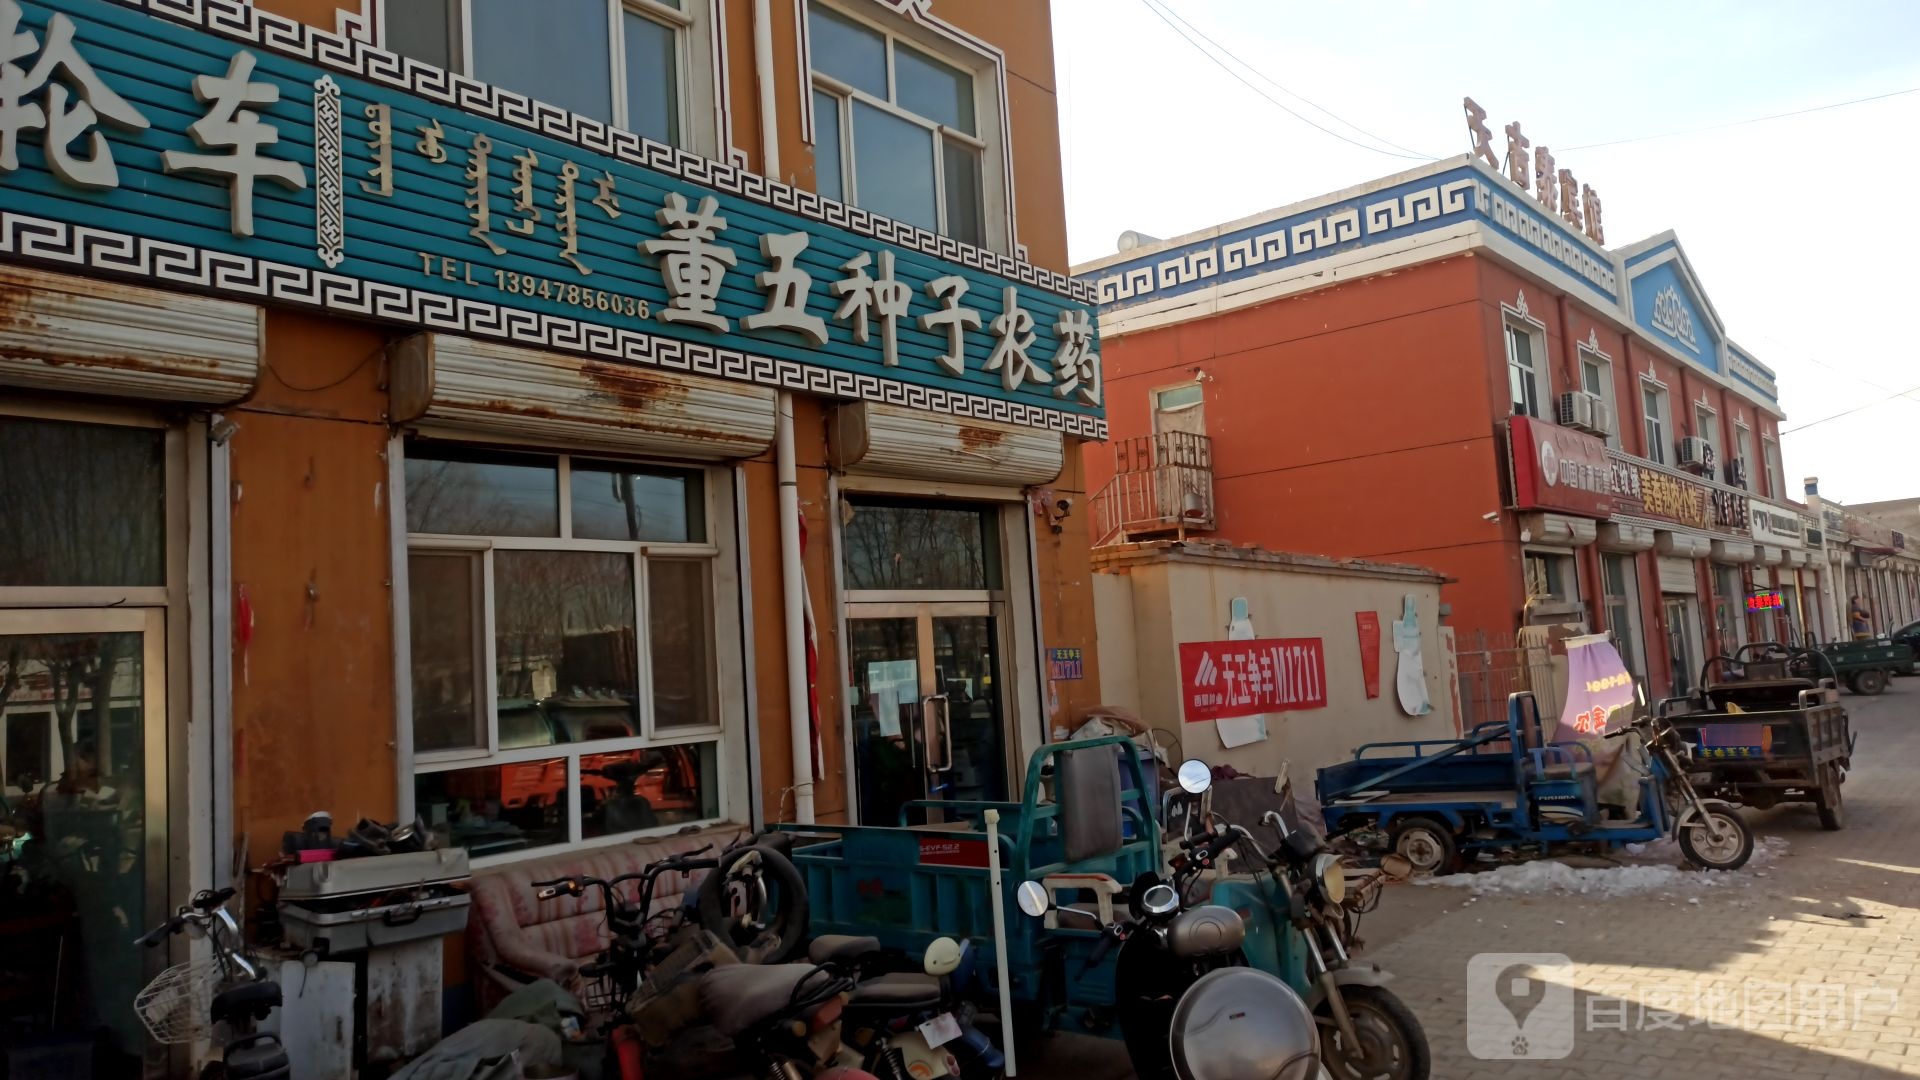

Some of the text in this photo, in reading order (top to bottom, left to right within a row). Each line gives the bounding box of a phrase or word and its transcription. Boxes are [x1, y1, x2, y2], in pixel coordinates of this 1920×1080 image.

[418, 252, 650, 320] TEL 13947856036
[637, 191, 1102, 407] 董五种子农药
